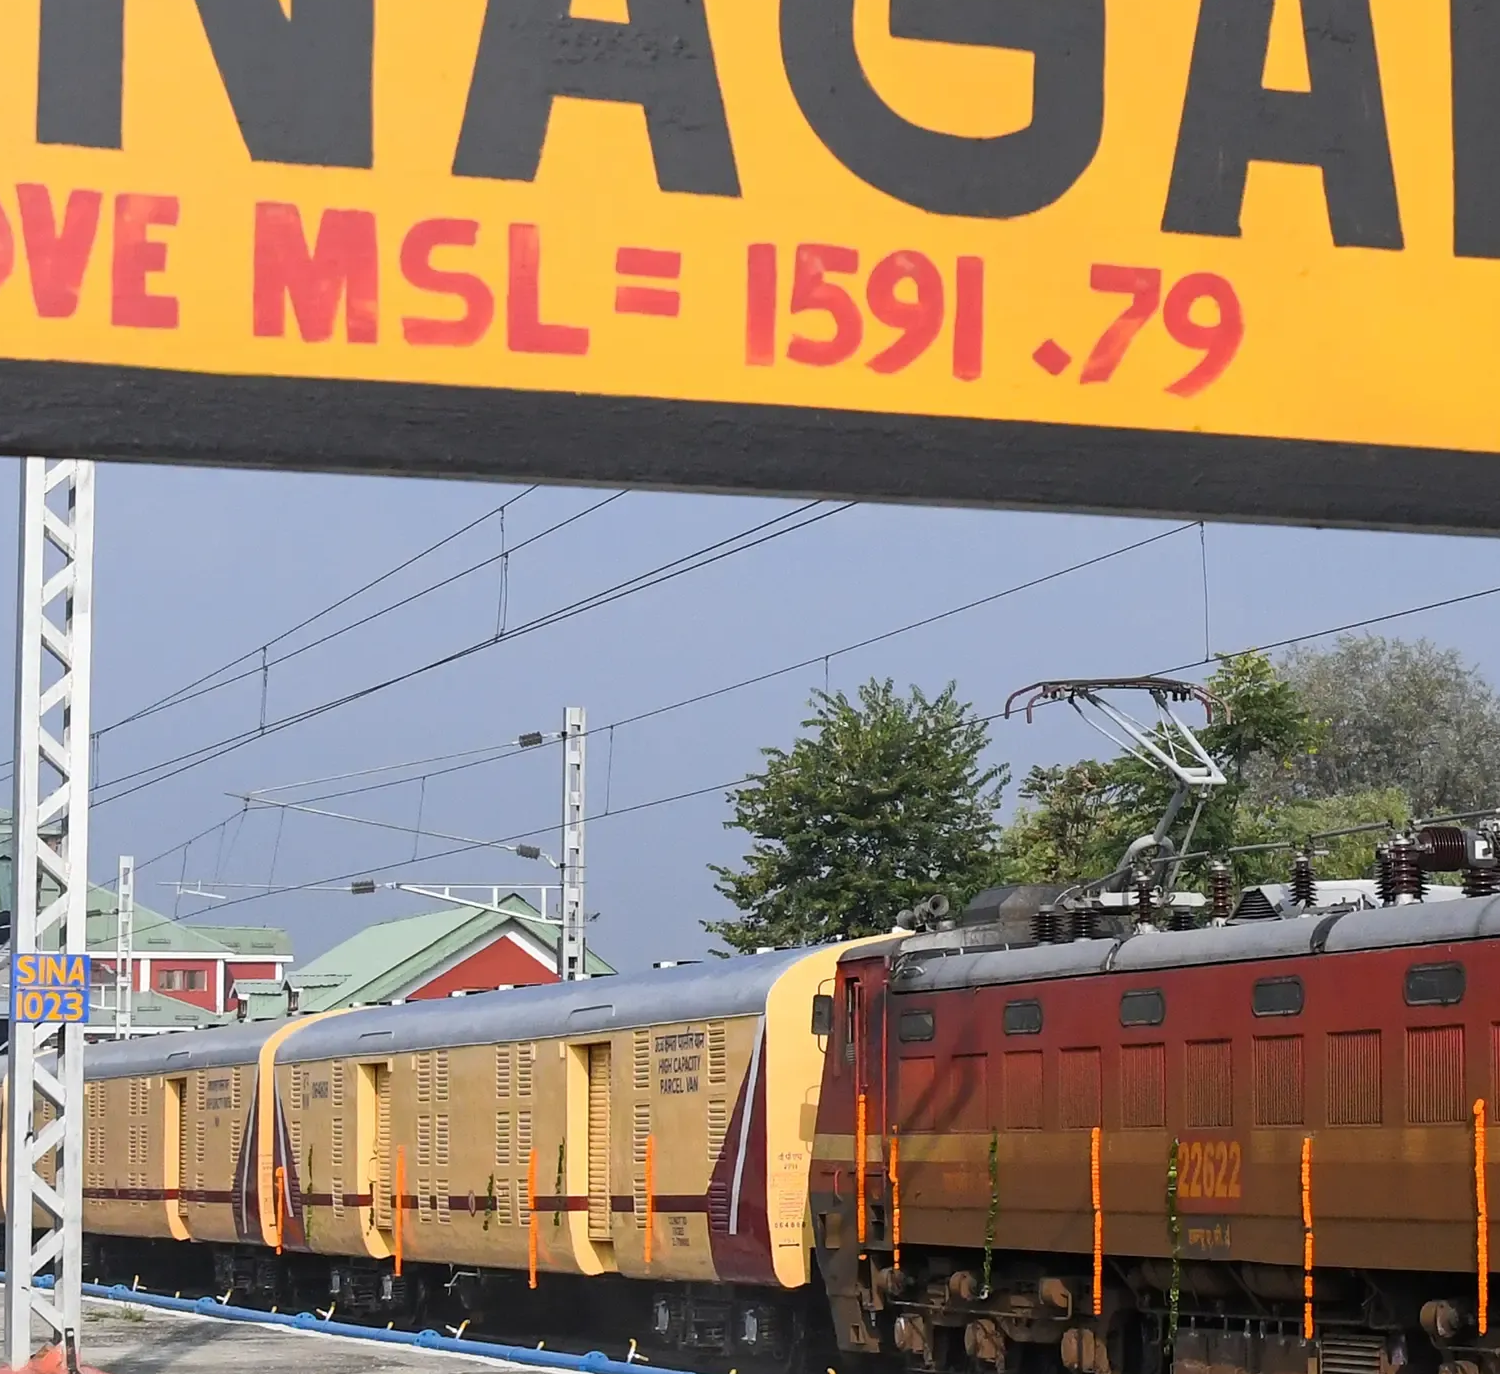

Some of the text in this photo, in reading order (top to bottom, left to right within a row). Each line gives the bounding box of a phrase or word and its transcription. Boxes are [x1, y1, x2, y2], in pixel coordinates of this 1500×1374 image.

[17, 955, 85, 985] SINA
[16, 991, 84, 1021] 1023
[673, 1055, 701, 1073] CAPACITY
[660, 1076, 699, 1094] PARCEL VAN
[1177, 1140, 1241, 1198] 22622
